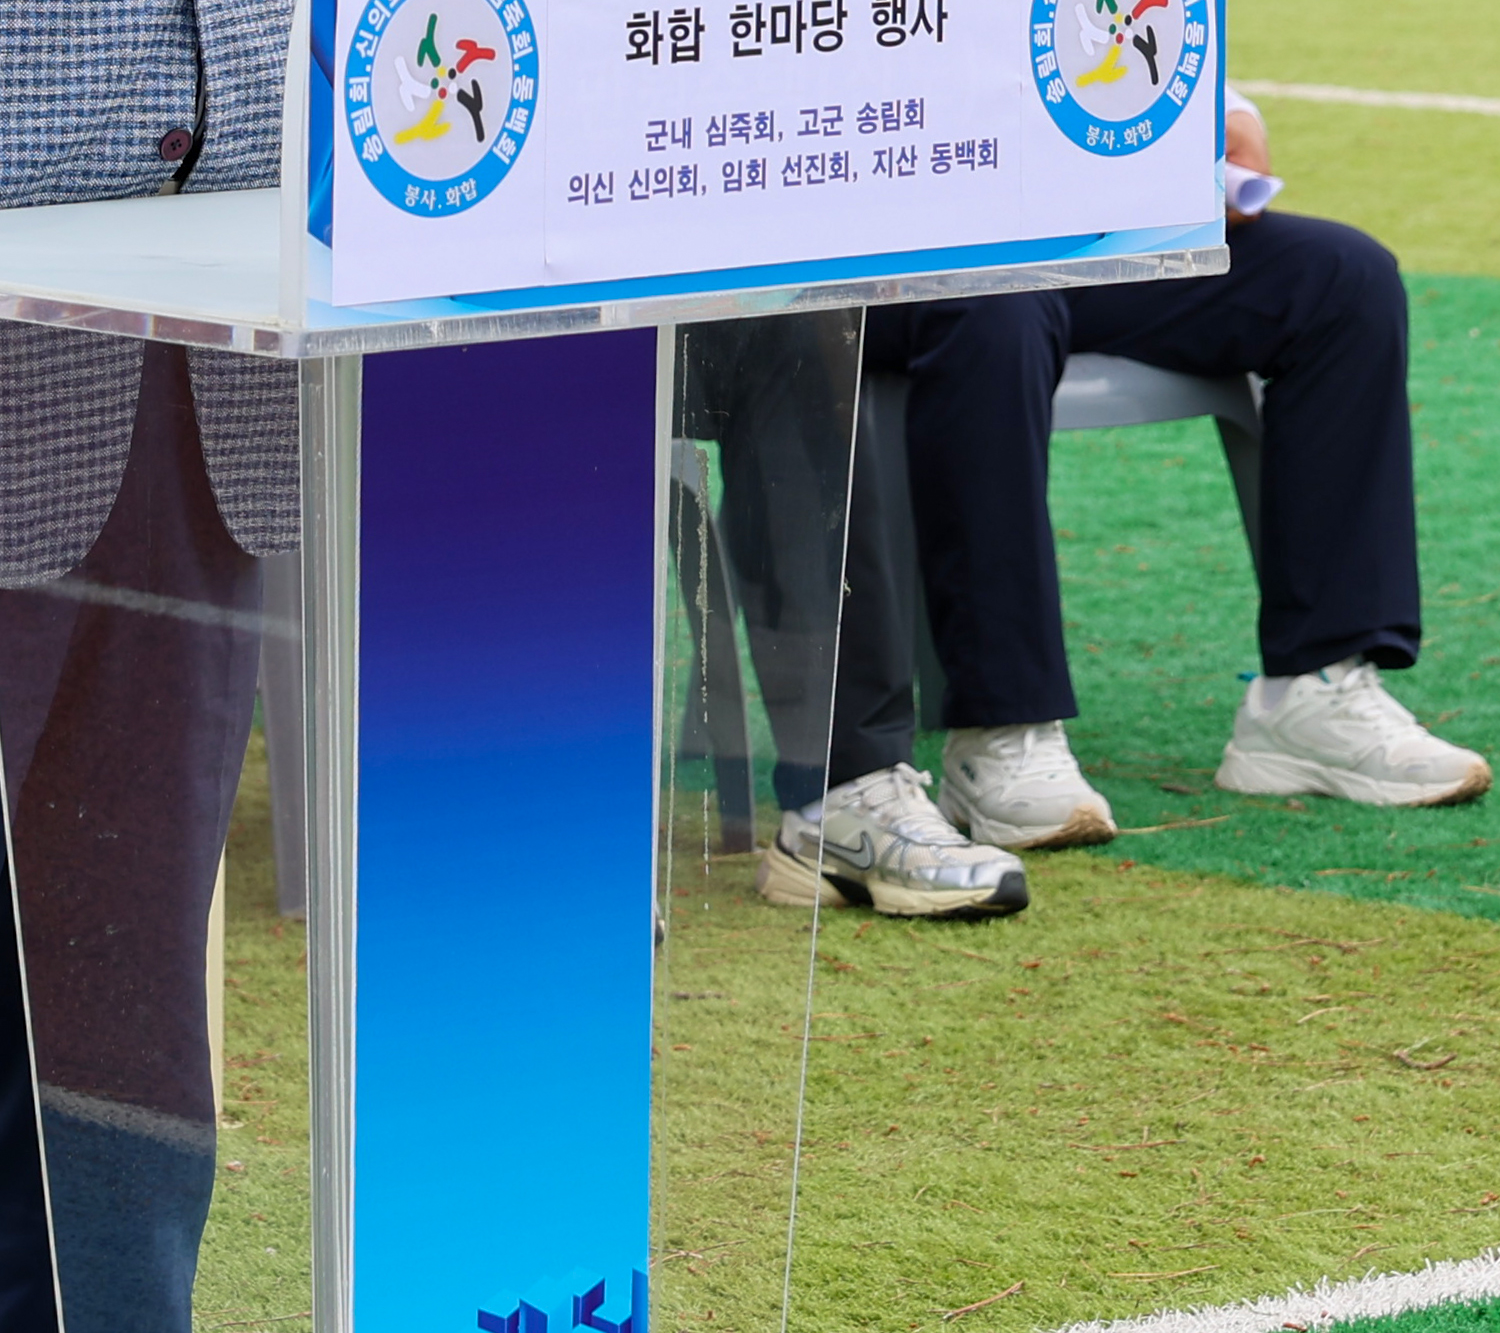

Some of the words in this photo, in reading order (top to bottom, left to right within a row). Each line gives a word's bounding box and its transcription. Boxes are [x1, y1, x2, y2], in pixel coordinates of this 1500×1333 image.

[625, 6, 704, 66] 화합
[644, 116, 693, 153] 군내
[705, 109, 784, 148] 심죽회,
[796, 104, 844, 137] 고군
[855, 96, 926, 134] 송림회
[567, 171, 615, 206] 의신
[628, 162, 707, 202] 신의회,
[721, 156, 768, 193] 임회
[780, 149, 859, 189] 선진회,
[872, 144, 918, 179] 지산
[929, 136, 999, 174] 동백회
